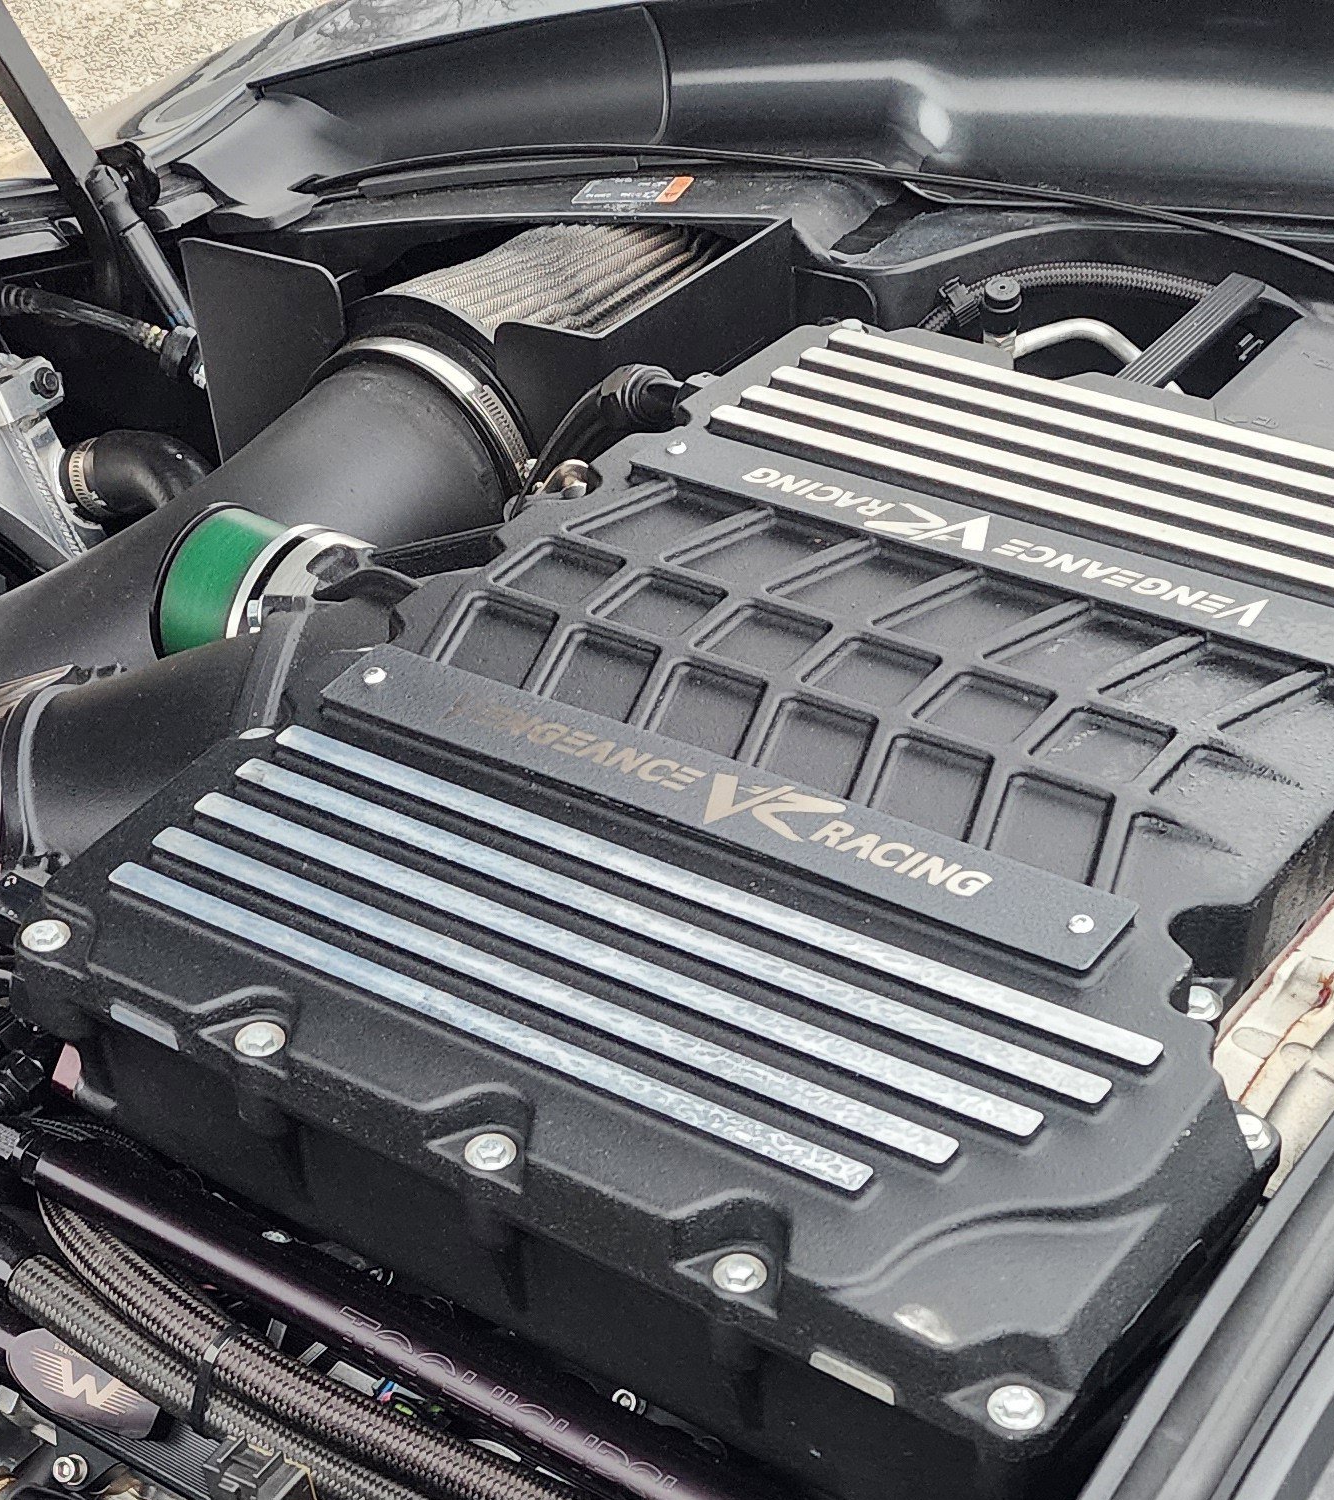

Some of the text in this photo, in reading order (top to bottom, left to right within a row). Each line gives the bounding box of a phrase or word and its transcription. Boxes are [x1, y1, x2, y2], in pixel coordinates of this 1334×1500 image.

[740, 467, 888, 517] RACING
[992, 537, 1270, 628] VENGEANCE
[437, 690, 708, 792] VENGEANCE
[809, 818, 994, 898] RACING
